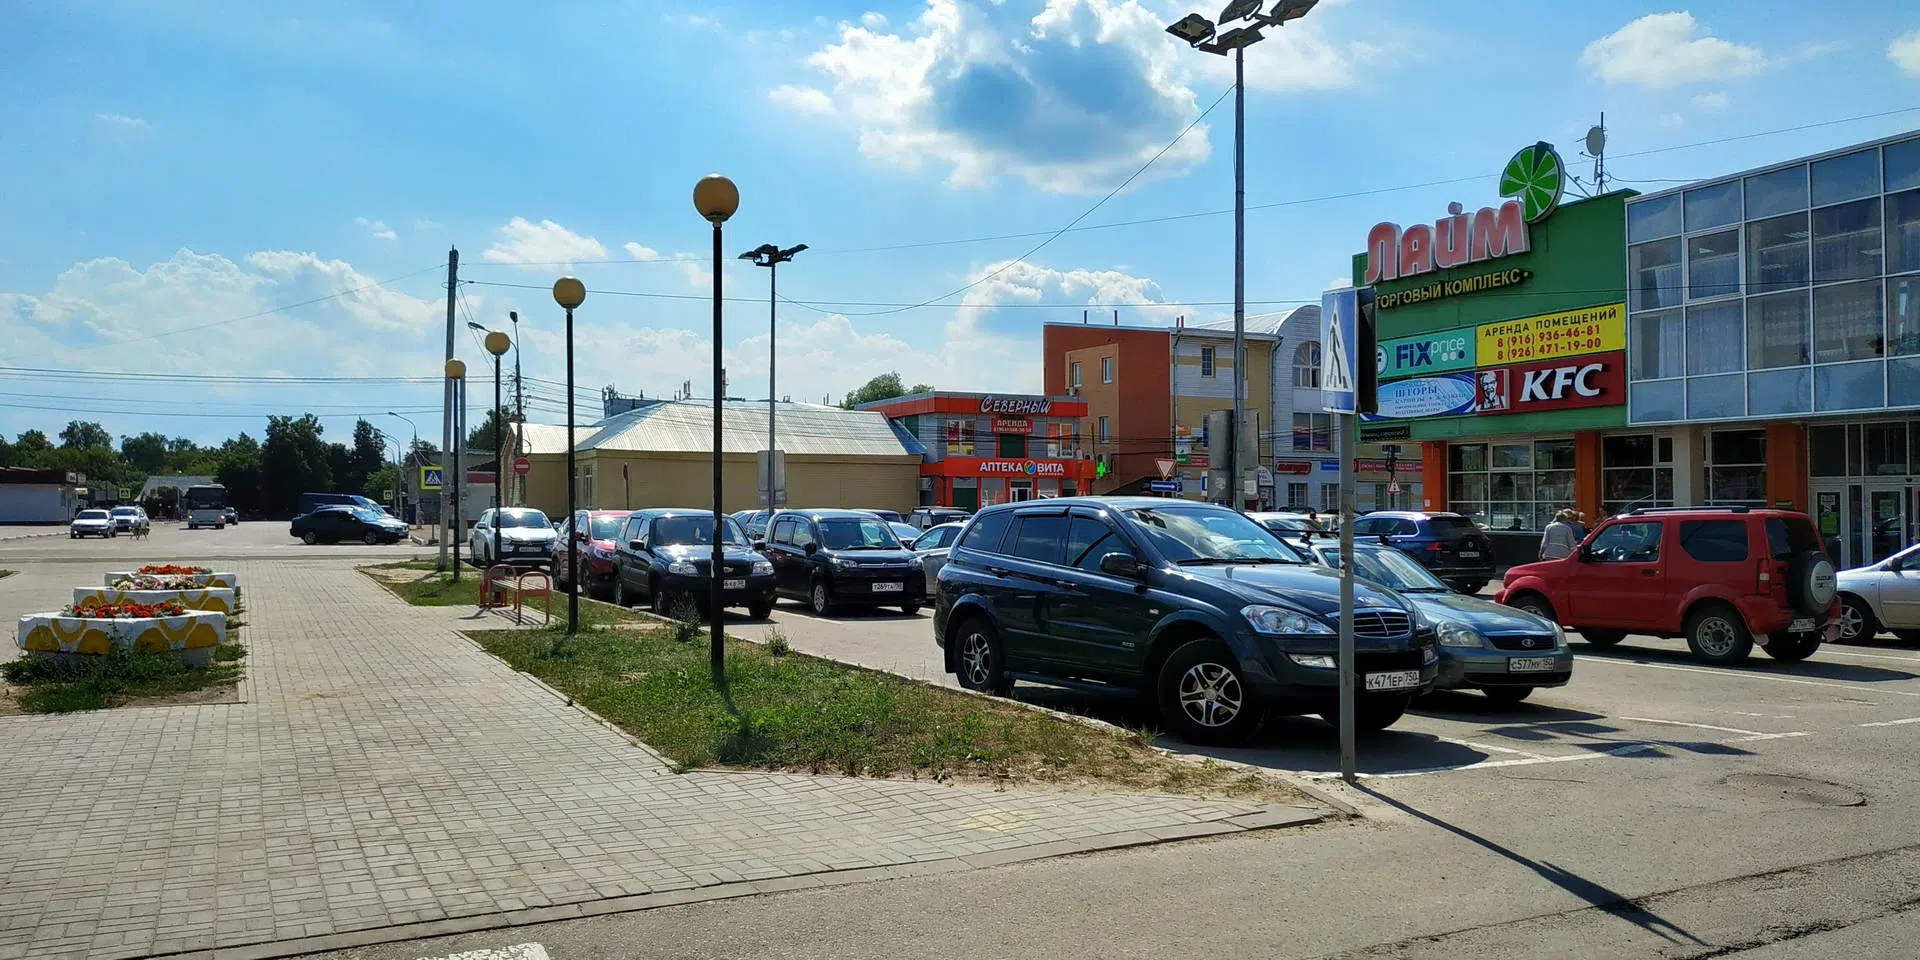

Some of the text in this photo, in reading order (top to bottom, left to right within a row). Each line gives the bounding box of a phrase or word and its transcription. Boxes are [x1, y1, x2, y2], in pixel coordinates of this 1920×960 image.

[1445, 268, 1521, 296] КОМПЛЕКС
[1485, 307, 1617, 337] АРЕНДА ПОМЕЩЕНИЙ
[1431, 337, 1465, 357] price
[1497, 324, 1601, 348] 8 (916) 936-46-81
[1497, 337, 1601, 361] 8 (926) 471-19-00
[1395, 386, 1437, 398] ШТОРЫ
[1519, 363, 1603, 402] KFC
[980, 462, 1064, 473] АПТЕКА ВИТА
